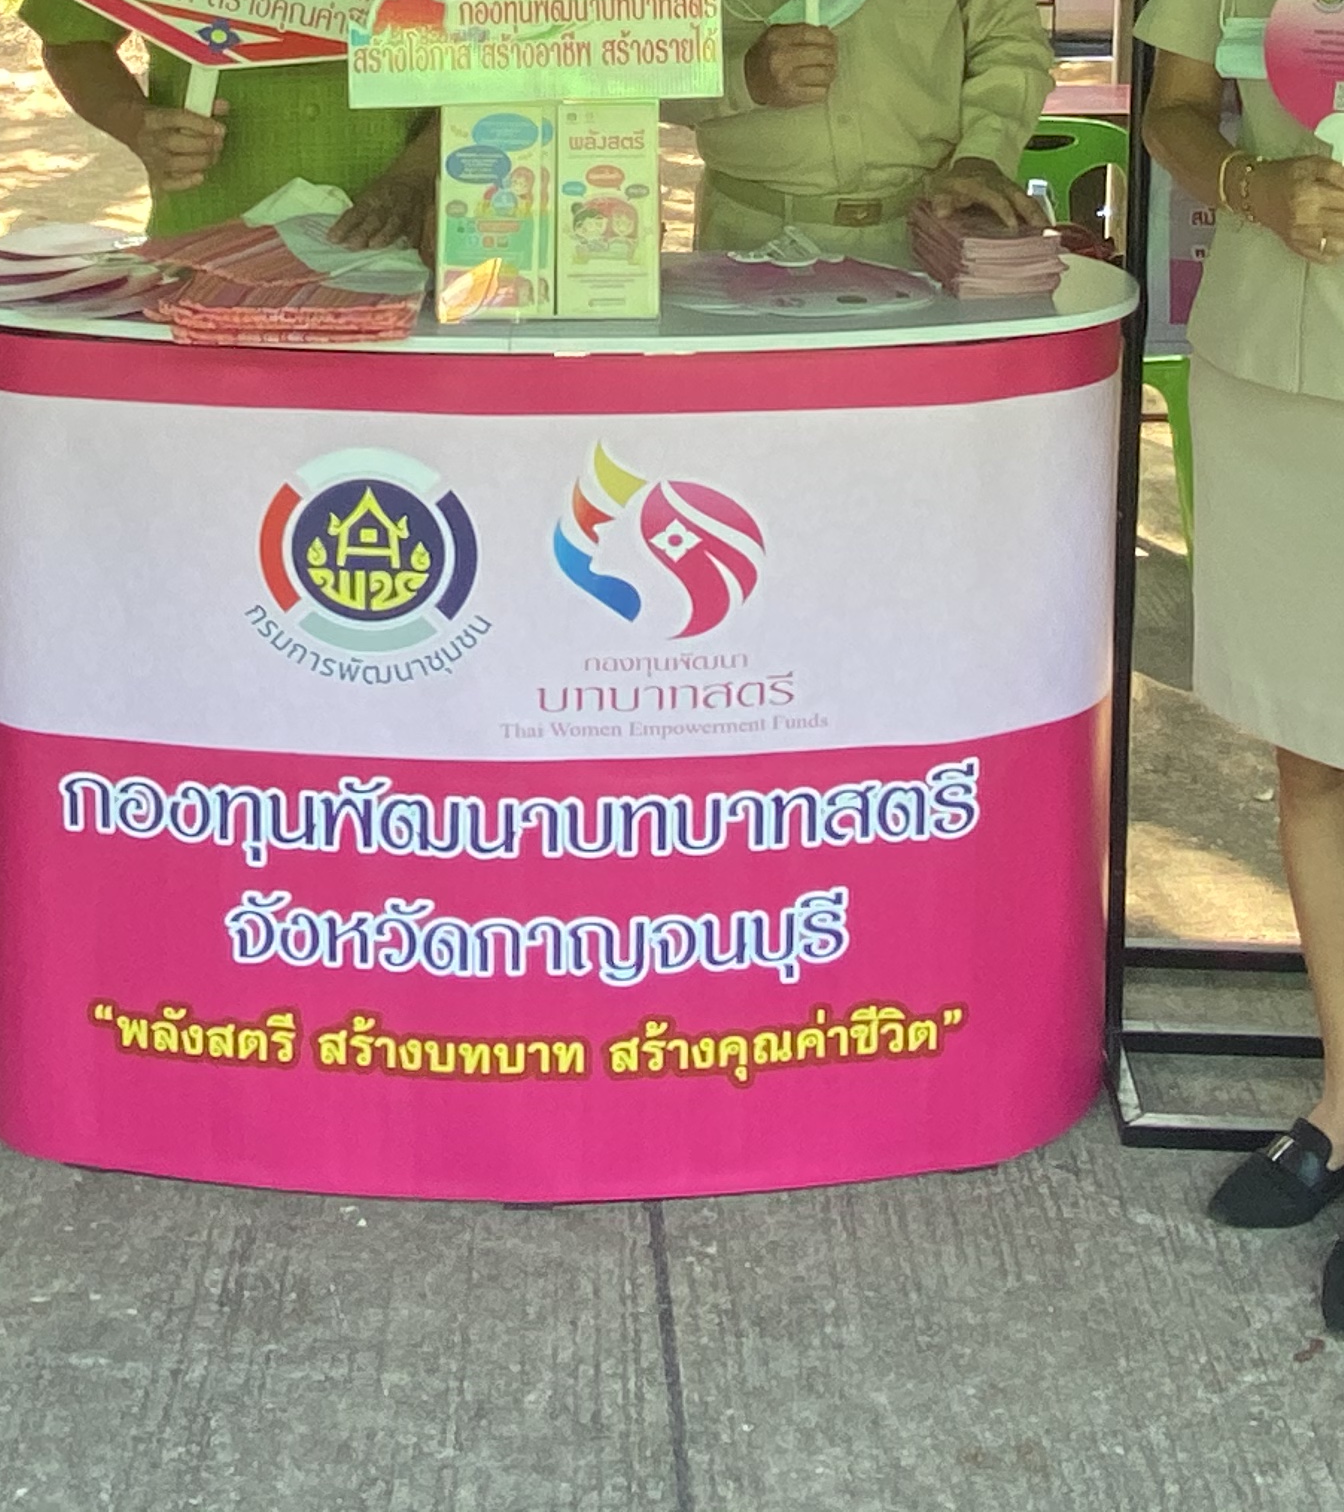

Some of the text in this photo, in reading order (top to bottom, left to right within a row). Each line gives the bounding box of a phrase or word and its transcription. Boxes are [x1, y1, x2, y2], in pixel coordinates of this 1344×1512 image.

[353, 23, 719, 75] สร้างโอกาส สร้างอาชีพ สร้างรายได้
[568, 129, 646, 152] พลังสตรี
[243, 600, 494, 686] กรมการพัฒนาชุมชน
[582, 648, 750, 677] กองทุนพัฒนา
[536, 668, 796, 714] บทบาทสตรี
[499, 714, 829, 740] Thai Women Empowerment Funds
[60, 756, 980, 866] กองทุนพัฒนาบทบาทสตรี
[224, 886, 849, 985] จังหวัดกาญจนบุรี
[93, 1002, 964, 1084] “พลังสตรี สร้างบทบาท สร้างคุณค่าชีวิต”
